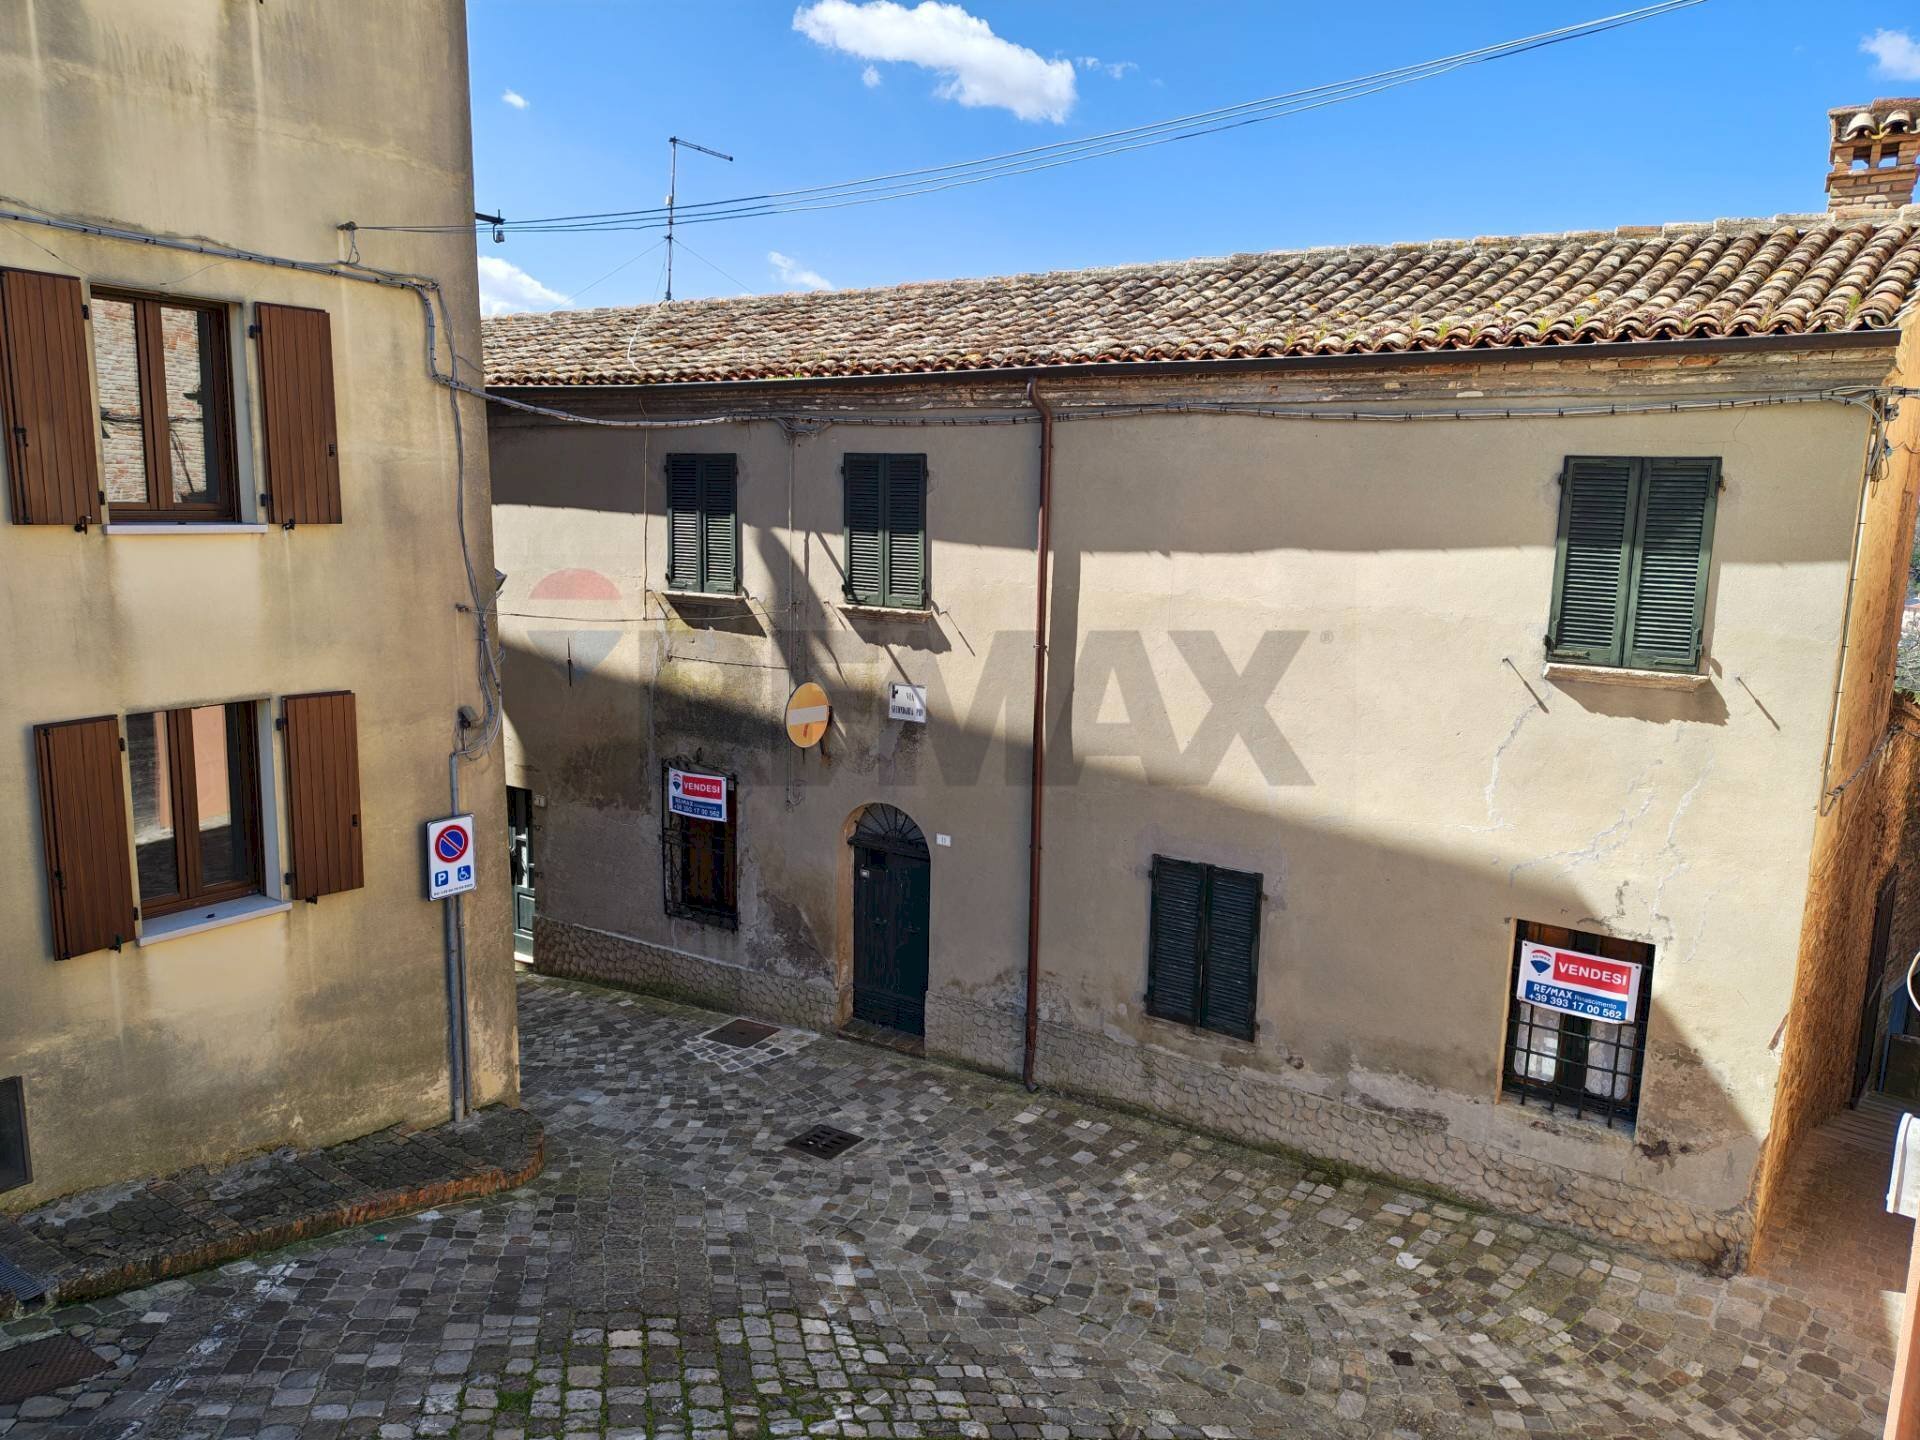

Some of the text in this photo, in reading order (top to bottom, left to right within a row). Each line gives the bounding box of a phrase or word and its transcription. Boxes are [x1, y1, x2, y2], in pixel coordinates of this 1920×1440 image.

[684, 782, 720, 793] VENDESI
[437, 872, 446, 885] P
[1558, 962, 1628, 986] VENDESI
[1533, 984, 1573, 1000] RE/MAX
[1529, 993, 1622, 1019] +39 393 17 00 562
